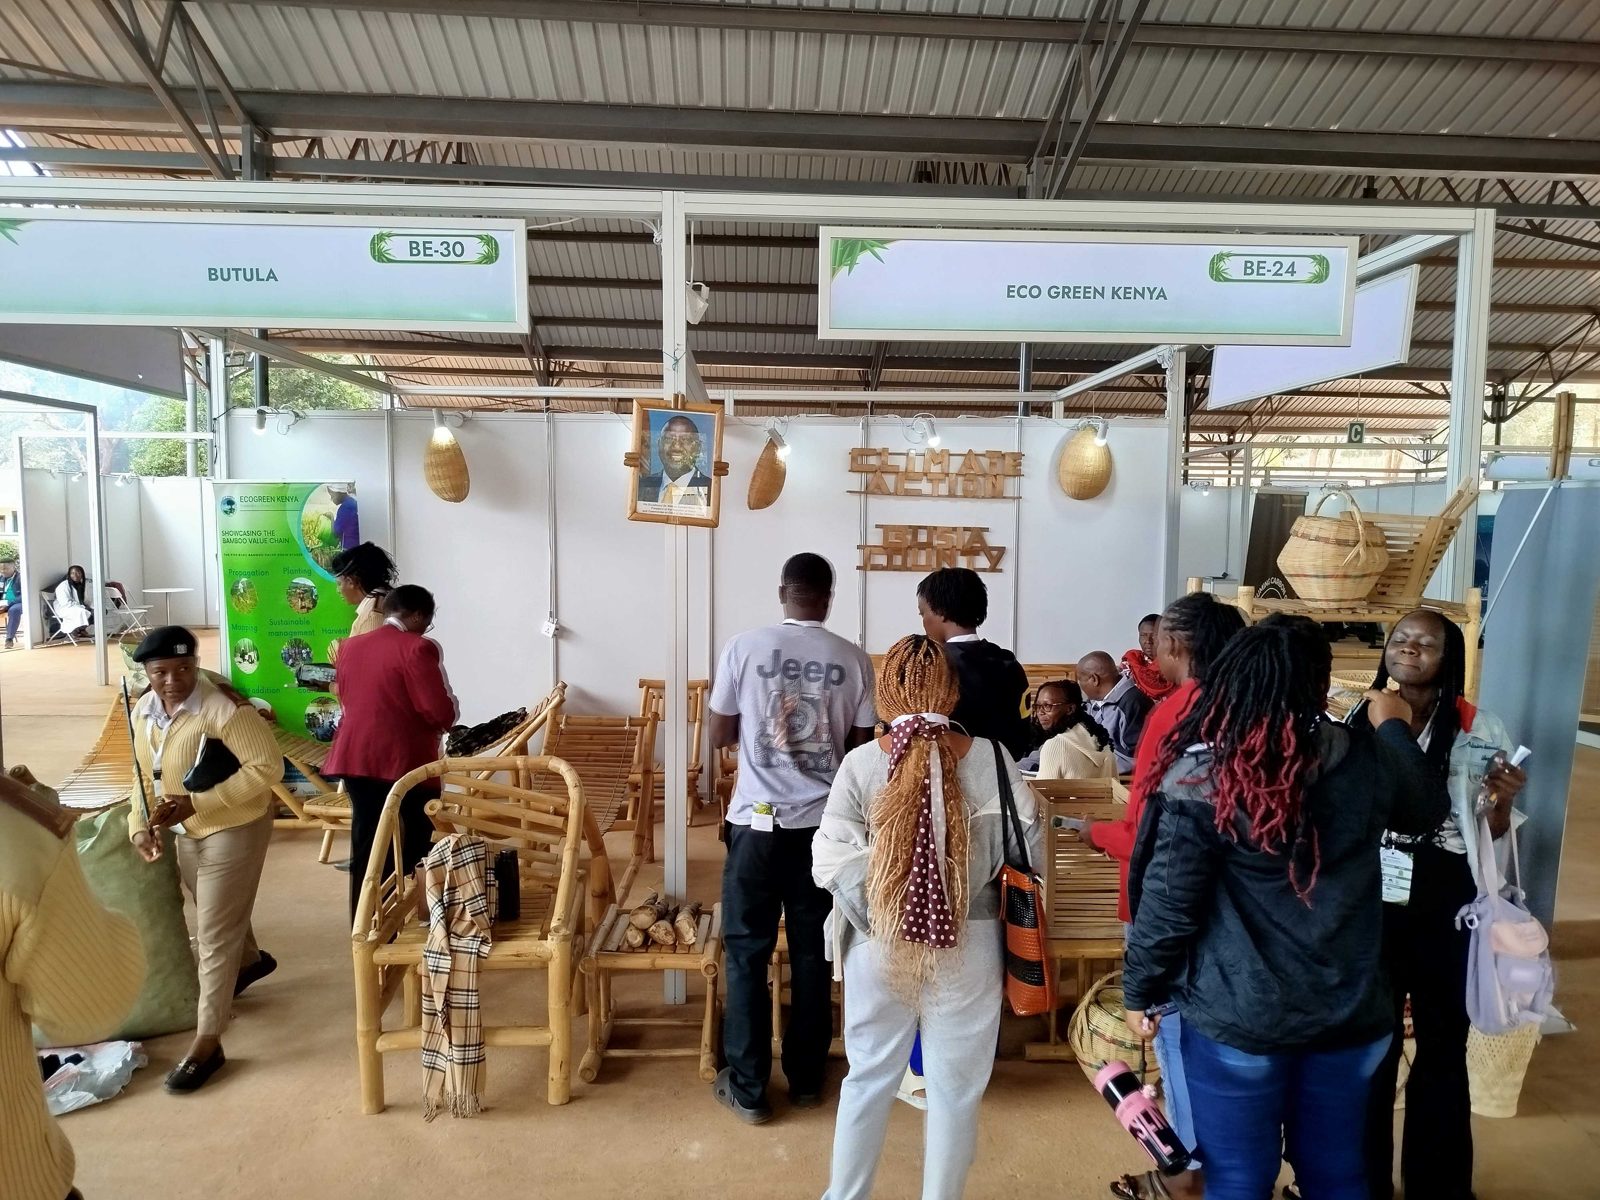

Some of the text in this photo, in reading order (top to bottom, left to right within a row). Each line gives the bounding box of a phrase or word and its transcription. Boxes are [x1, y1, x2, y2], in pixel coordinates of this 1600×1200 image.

[408, 240, 465, 258] BE-30
[207, 267, 279, 282] BUTULA
[1243, 260, 1297, 277] BE-24
[1006, 284, 1168, 301] ECO GREEN KENYA
[1351, 424, 1362, 442] C
[851, 447, 1023, 476] CLIMATE
[866, 469, 1004, 498] ACTION
[239, 495, 299, 503] ECOGREEN KENYA
[882, 525, 989, 549] BUSIA
[863, 546, 1006, 572] COUNTY
[228, 567, 312, 578] Propagation Planting
[268, 618, 311, 626] Sustainable
[231, 624, 258, 634] Mapping
[268, 629, 315, 638] management
[756, 648, 847, 690] Jeep
